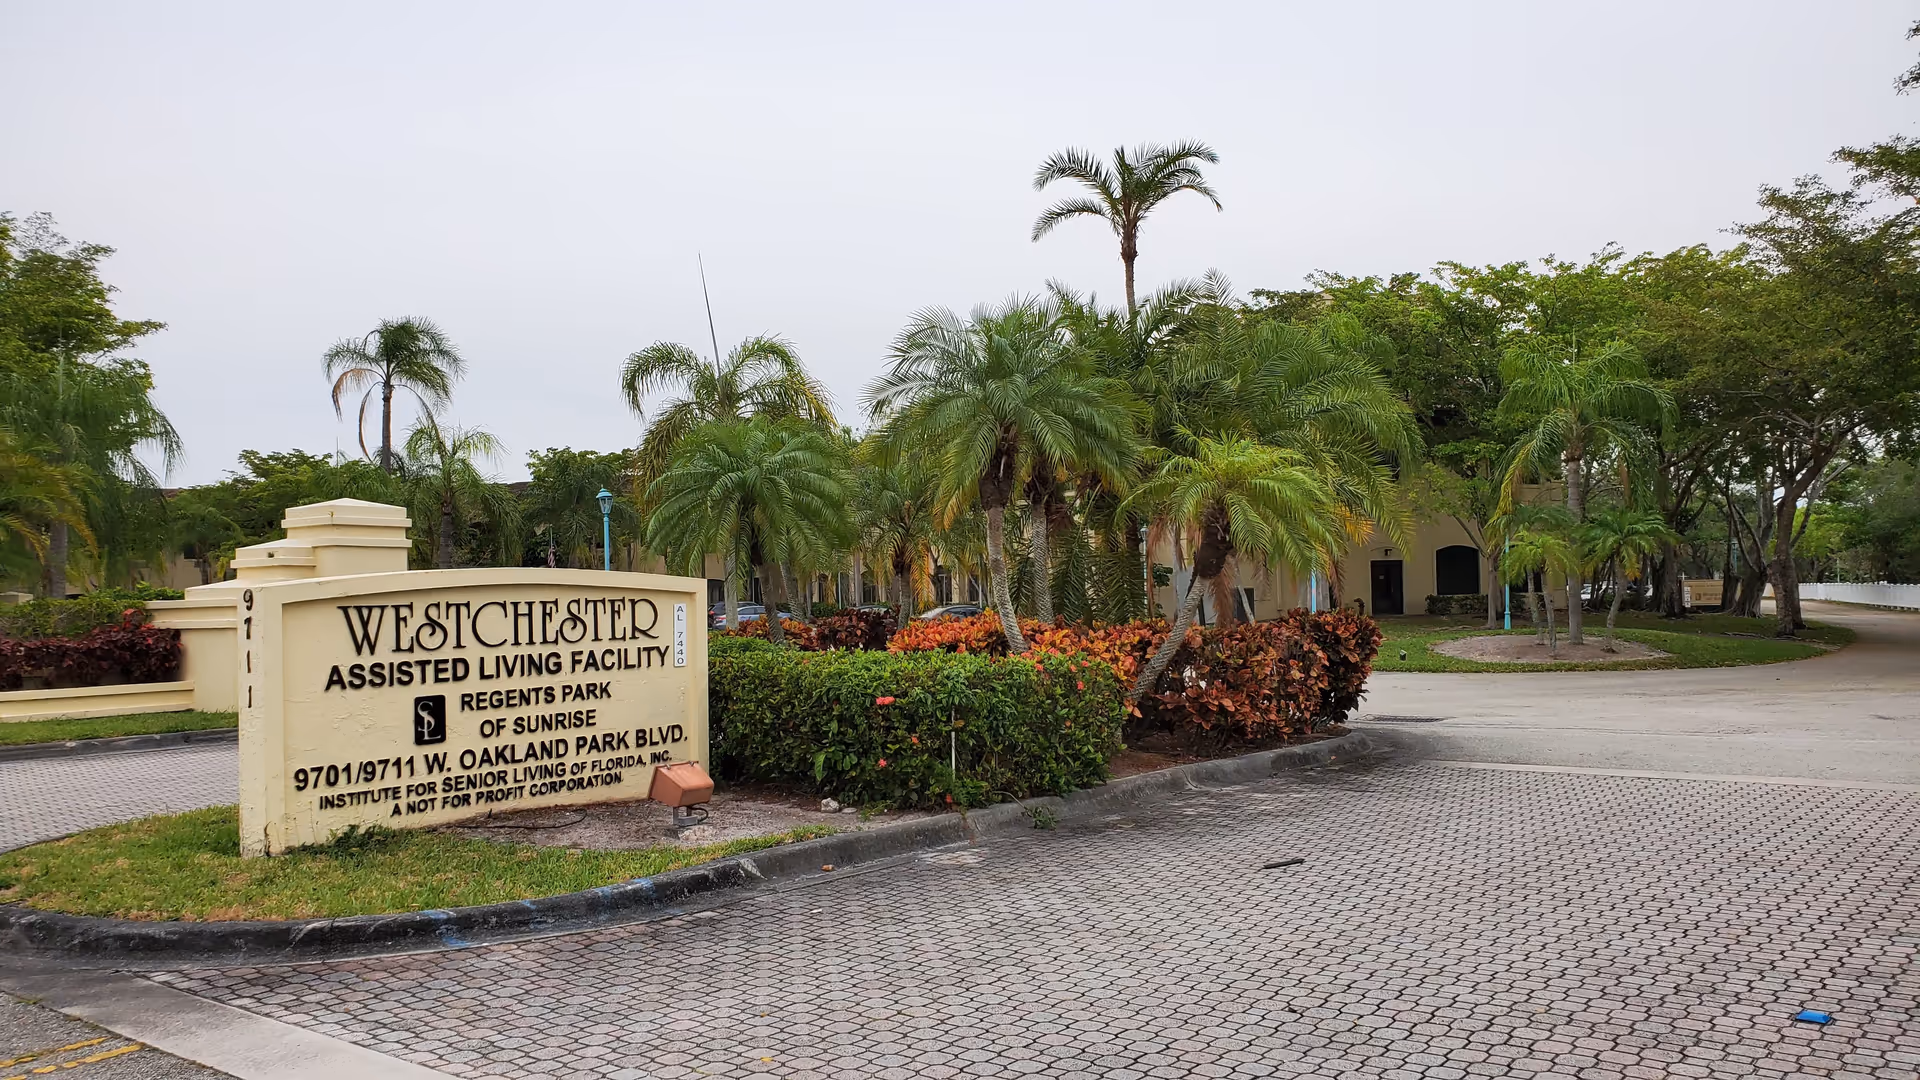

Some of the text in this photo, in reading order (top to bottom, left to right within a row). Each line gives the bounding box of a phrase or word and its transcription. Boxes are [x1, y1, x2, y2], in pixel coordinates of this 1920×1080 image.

[337, 597, 659, 655] WESTCHESTER
[325, 645, 670, 691] ASSISTED LIVING FACILITY
[460, 681, 612, 712] REGENTS PARK
[479, 709, 597, 738] OF SUNRISE
[294, 724, 688, 791] 9701/9711 W. OAKLAND PARK BLVD.
[319, 750, 672, 810] INSTITUTE FOR SENIOR LIVING OF FLORIDA, INC.
[390, 803, 402, 818] A
[406, 800, 437, 815] NOT
[441, 794, 471, 809] FOR
[475, 785, 525, 805] PROFIT
